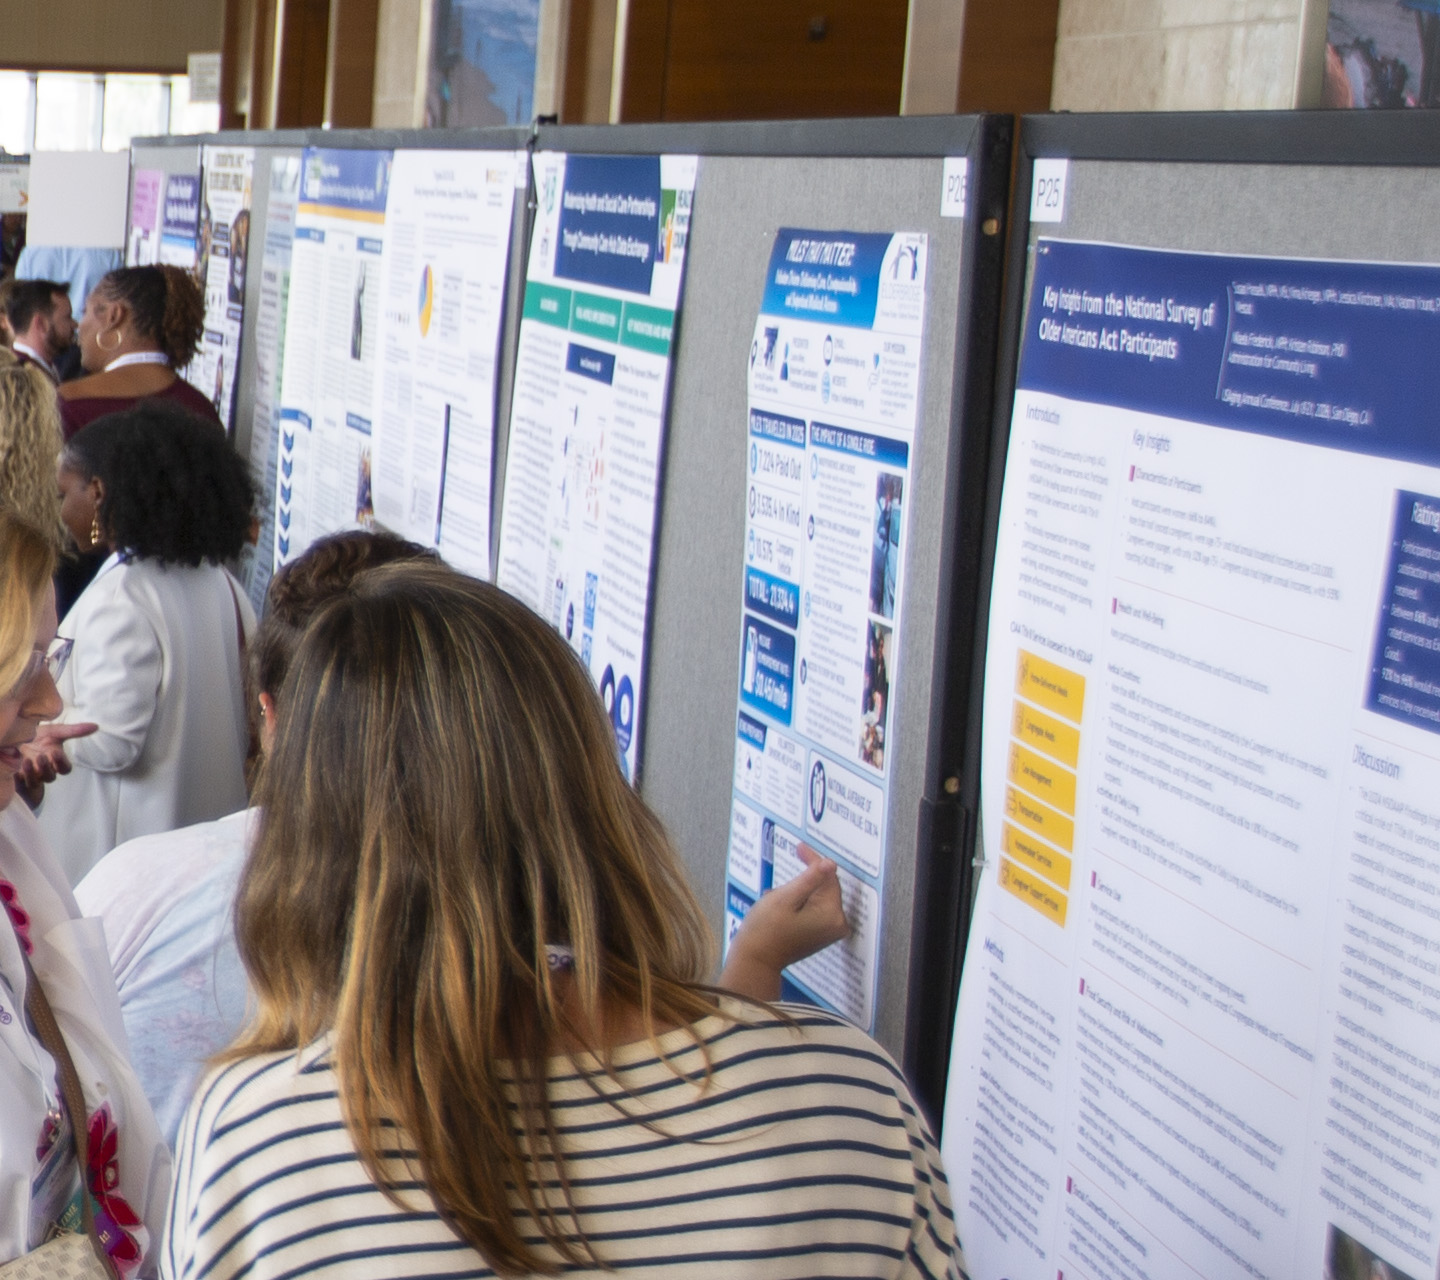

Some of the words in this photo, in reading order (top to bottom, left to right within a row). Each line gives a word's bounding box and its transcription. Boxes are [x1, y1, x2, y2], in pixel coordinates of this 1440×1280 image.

[1037, 177, 1060, 208] P25
[1042, 285, 1058, 313] Key
[1059, 287, 1081, 317] Insights
[1081, 290, 1103, 316] from
[1105, 292, 1124, 318] the
[1125, 295, 1166, 322] National
[1167, 298, 1201, 332] Survey
[1202, 302, 1217, 328] of
[1039, 317, 1062, 343] Older
[1062, 321, 1098, 349] Americans
[1099, 327, 1119, 352] Act
[1120, 328, 1178, 362] Participants
[1132, 429, 1145, 452] Key
[1145, 431, 1171, 456] Insights
[776, 452, 789, 478] Paid
[790, 456, 801, 481] Out
[786, 501, 800, 527] Kind
[1352, 743, 1401, 780] Discussion
